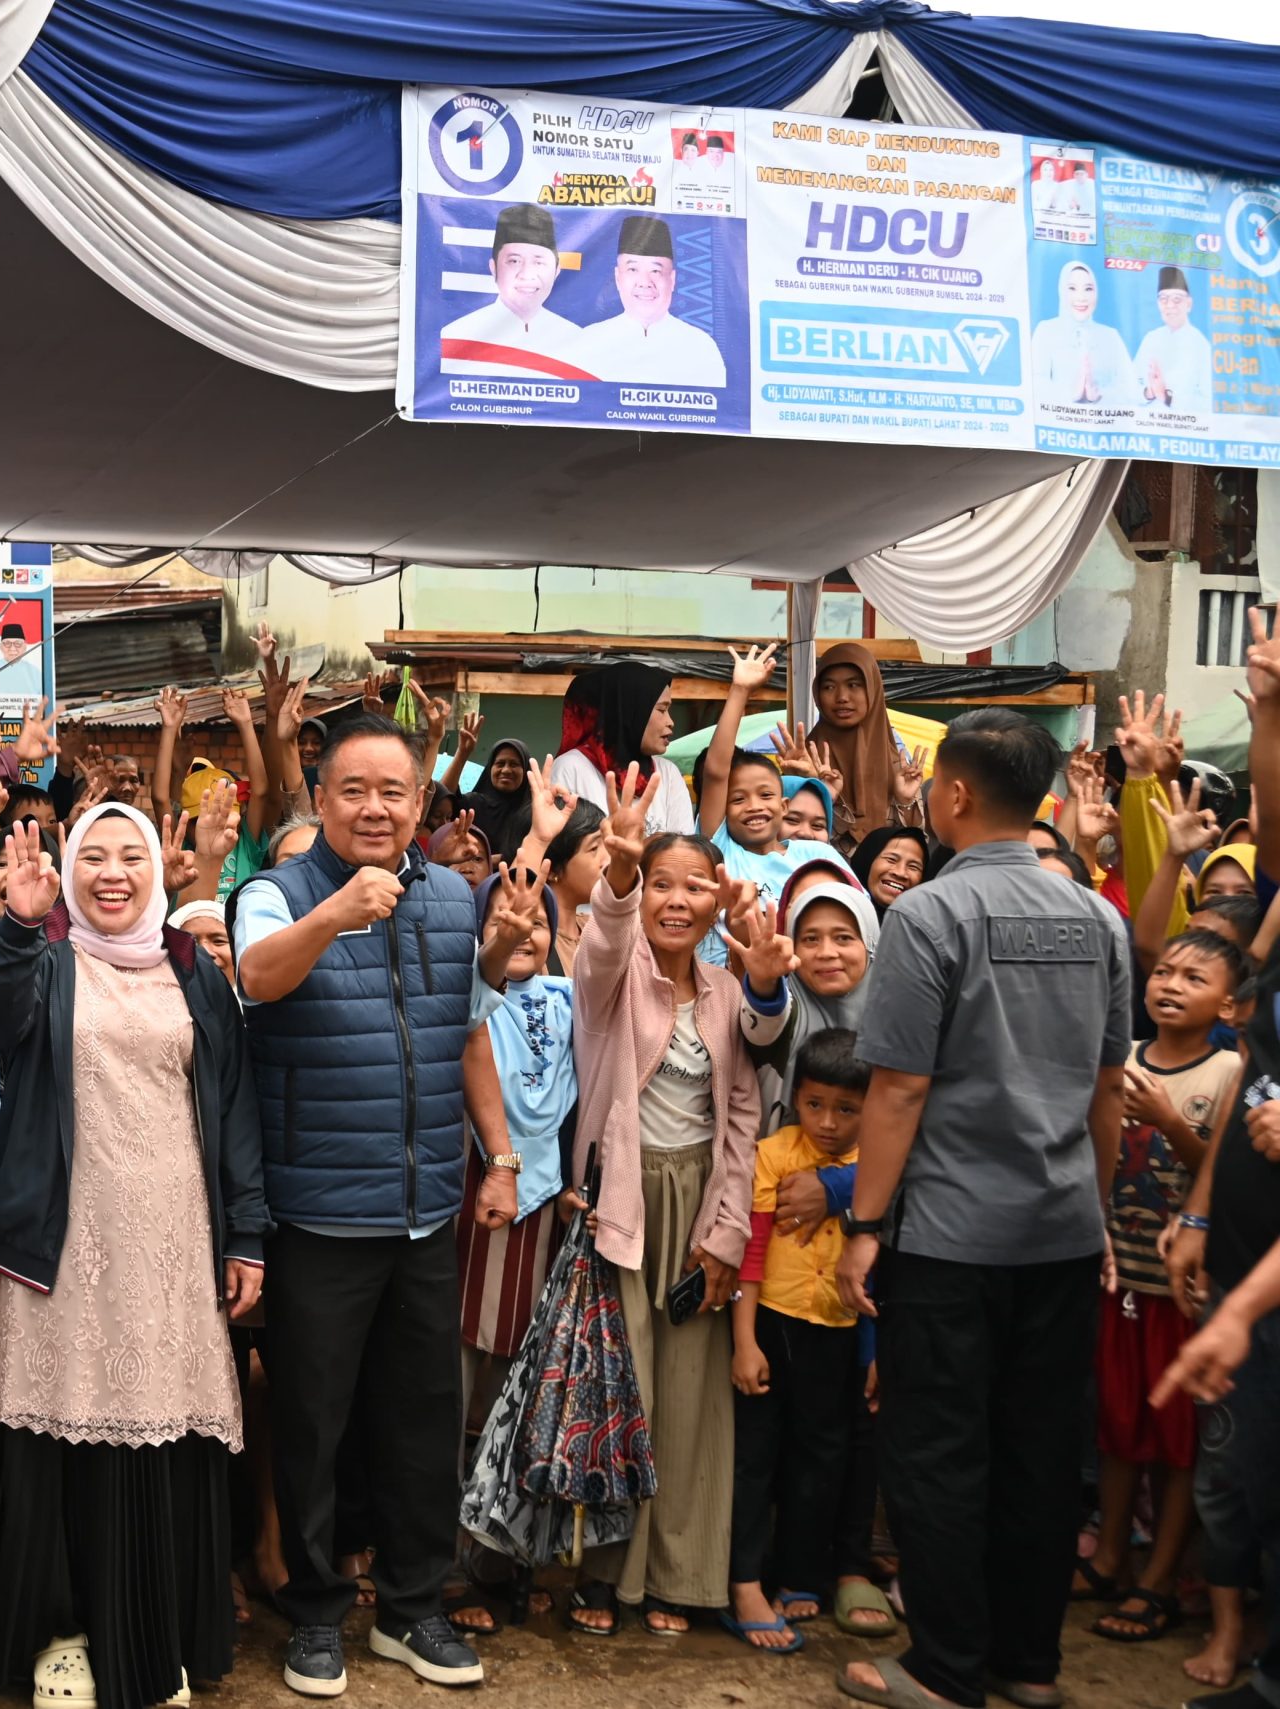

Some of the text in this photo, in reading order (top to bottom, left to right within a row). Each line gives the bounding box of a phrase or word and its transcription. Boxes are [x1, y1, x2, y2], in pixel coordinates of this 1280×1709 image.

[453, 96, 499, 115] NOMOR
[532, 105, 656, 135] PILIH HDCU
[456, 120, 484, 171] 1
[532, 130, 634, 151] NOMOR SATU
[773, 122, 1000, 158] KAMI SIAP MENDUKUNG
[532, 145, 662, 165] UNTUK SUMATERA SELATAN TERUS MAJU
[866, 155, 907, 173] DAN
[562, 173, 626, 187] MENYALA
[1105, 161, 1195, 187] BERLIAN
[537, 184, 655, 206] ABANGKU!
[757, 166, 1017, 204] MEMENANGKAN PASANGAN
[805, 201, 970, 259] HDCU
[1195, 233, 1222, 253] CU
[803, 260, 815, 273] H.
[817, 261, 865, 276] HERMAN
[868, 264, 899, 277] DERU
[908, 267, 920, 279] H.
[921, 268, 940, 281] CIK
[942, 269, 978, 284] UJANG
[1107, 259, 1144, 271] 2024
[775, 279, 807, 290] SEBAGAI
[809, 281, 851, 293] GUBERNUR
[853, 284, 868, 293] DAN
[871, 284, 894, 295] WAKIL
[896, 286, 935, 298] GUBERNUR
[936, 289, 964, 301] SUMSEL
[966, 292, 982, 302] 2024
[989, 293, 1005, 303] 2029
[776, 325, 949, 365] BERLIAN
[451, 382, 576, 399] H.HERMAN DERU
[621, 390, 714, 406] H.CIK UJANG
[768, 387, 781, 400] Hj.
[783, 387, 837, 402] LIDYAWATI,
[894, 394, 903, 405] H.
[906, 395, 957, 410] HARYANTO,
[960, 398, 974, 411] SE,
[450, 403, 533, 416] CALON GUBERNUR
[606, 411, 716, 424] CALON WAKIL GUBERNUR
[1040, 404, 1135, 418] HJ. LIDYAWATI CIK UJANG
[1158, 412, 1197, 423] HARYANTO
[779, 411, 816, 422] SEBAGAI
[818, 412, 850, 424] BUPATI
[852, 414, 869, 424] DAN
[872, 415, 899, 427] WAKIL
[901, 417, 932, 429] BUPATI
[934, 418, 960, 430] LAHAT
[964, 420, 983, 431] 2024
[1038, 429, 1156, 456] PENGALAMAN,
[1159, 438, 1220, 462] PEDULI,
[996, 923, 1093, 954] WALPRI
